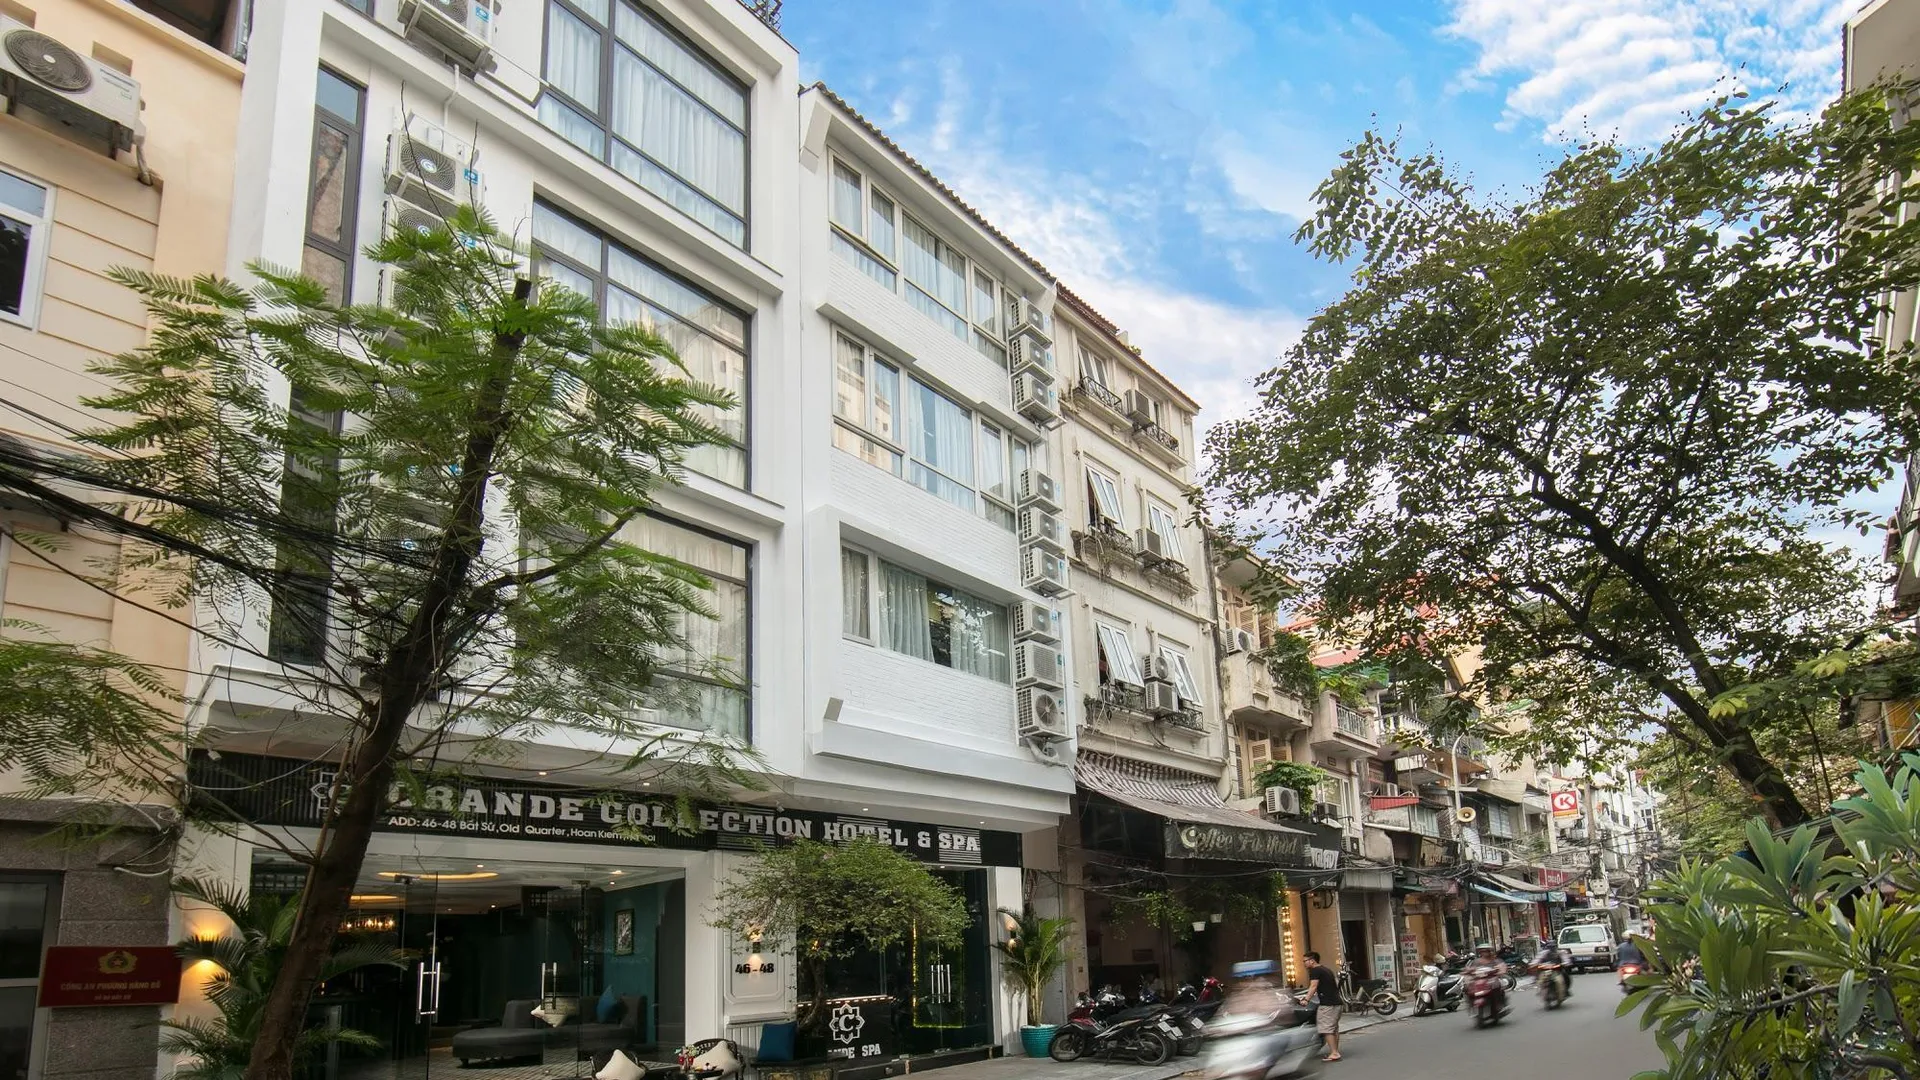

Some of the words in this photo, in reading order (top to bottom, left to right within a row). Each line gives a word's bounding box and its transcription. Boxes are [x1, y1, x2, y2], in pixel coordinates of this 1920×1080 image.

[388, 816, 420, 827] ADD:
[422, 818, 457, 829] 46-48
[917, 831, 931, 848] &
[938, 832, 981, 851] SPA
[862, 1043, 881, 1057] SPA
